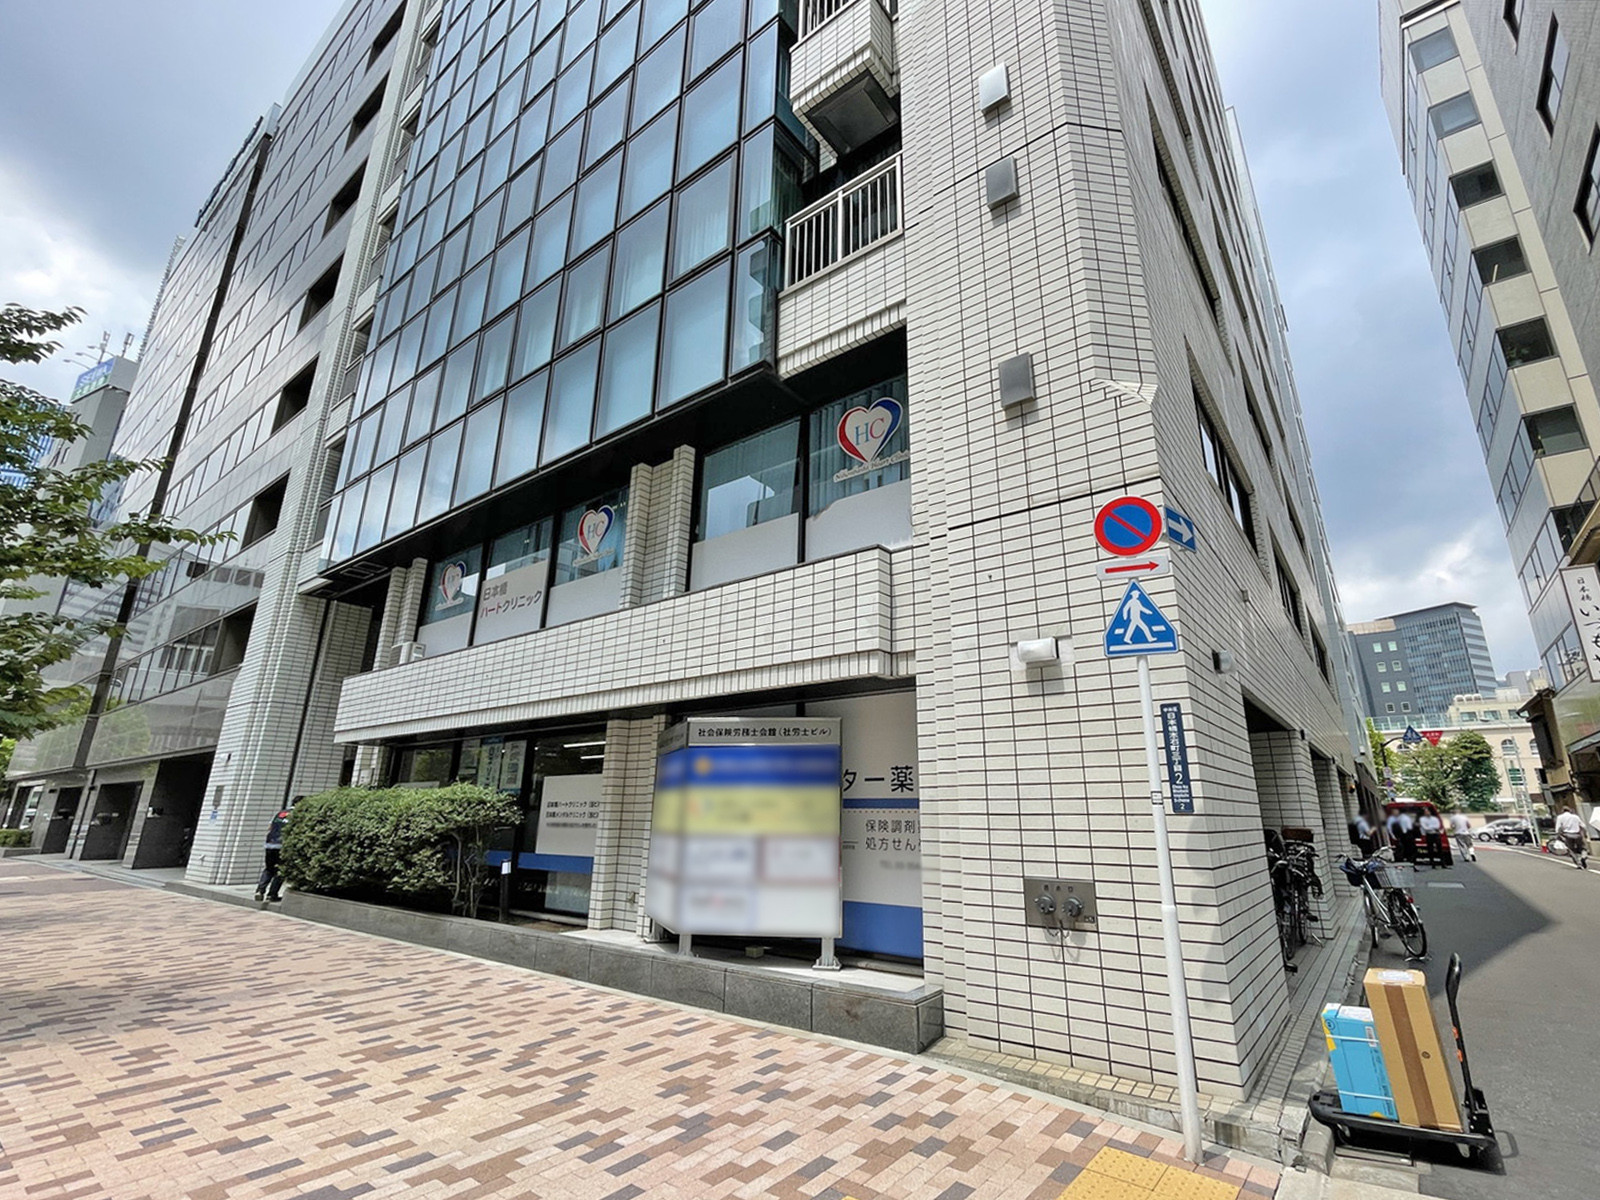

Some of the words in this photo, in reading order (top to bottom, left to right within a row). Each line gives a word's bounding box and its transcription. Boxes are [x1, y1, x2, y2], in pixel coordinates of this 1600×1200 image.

[855, 417, 885, 446] HC
[483, 581, 508, 601] 日本橋
[480, 590, 542, 618] ハートクリニック
[1175, 773, 1183, 784] 2
